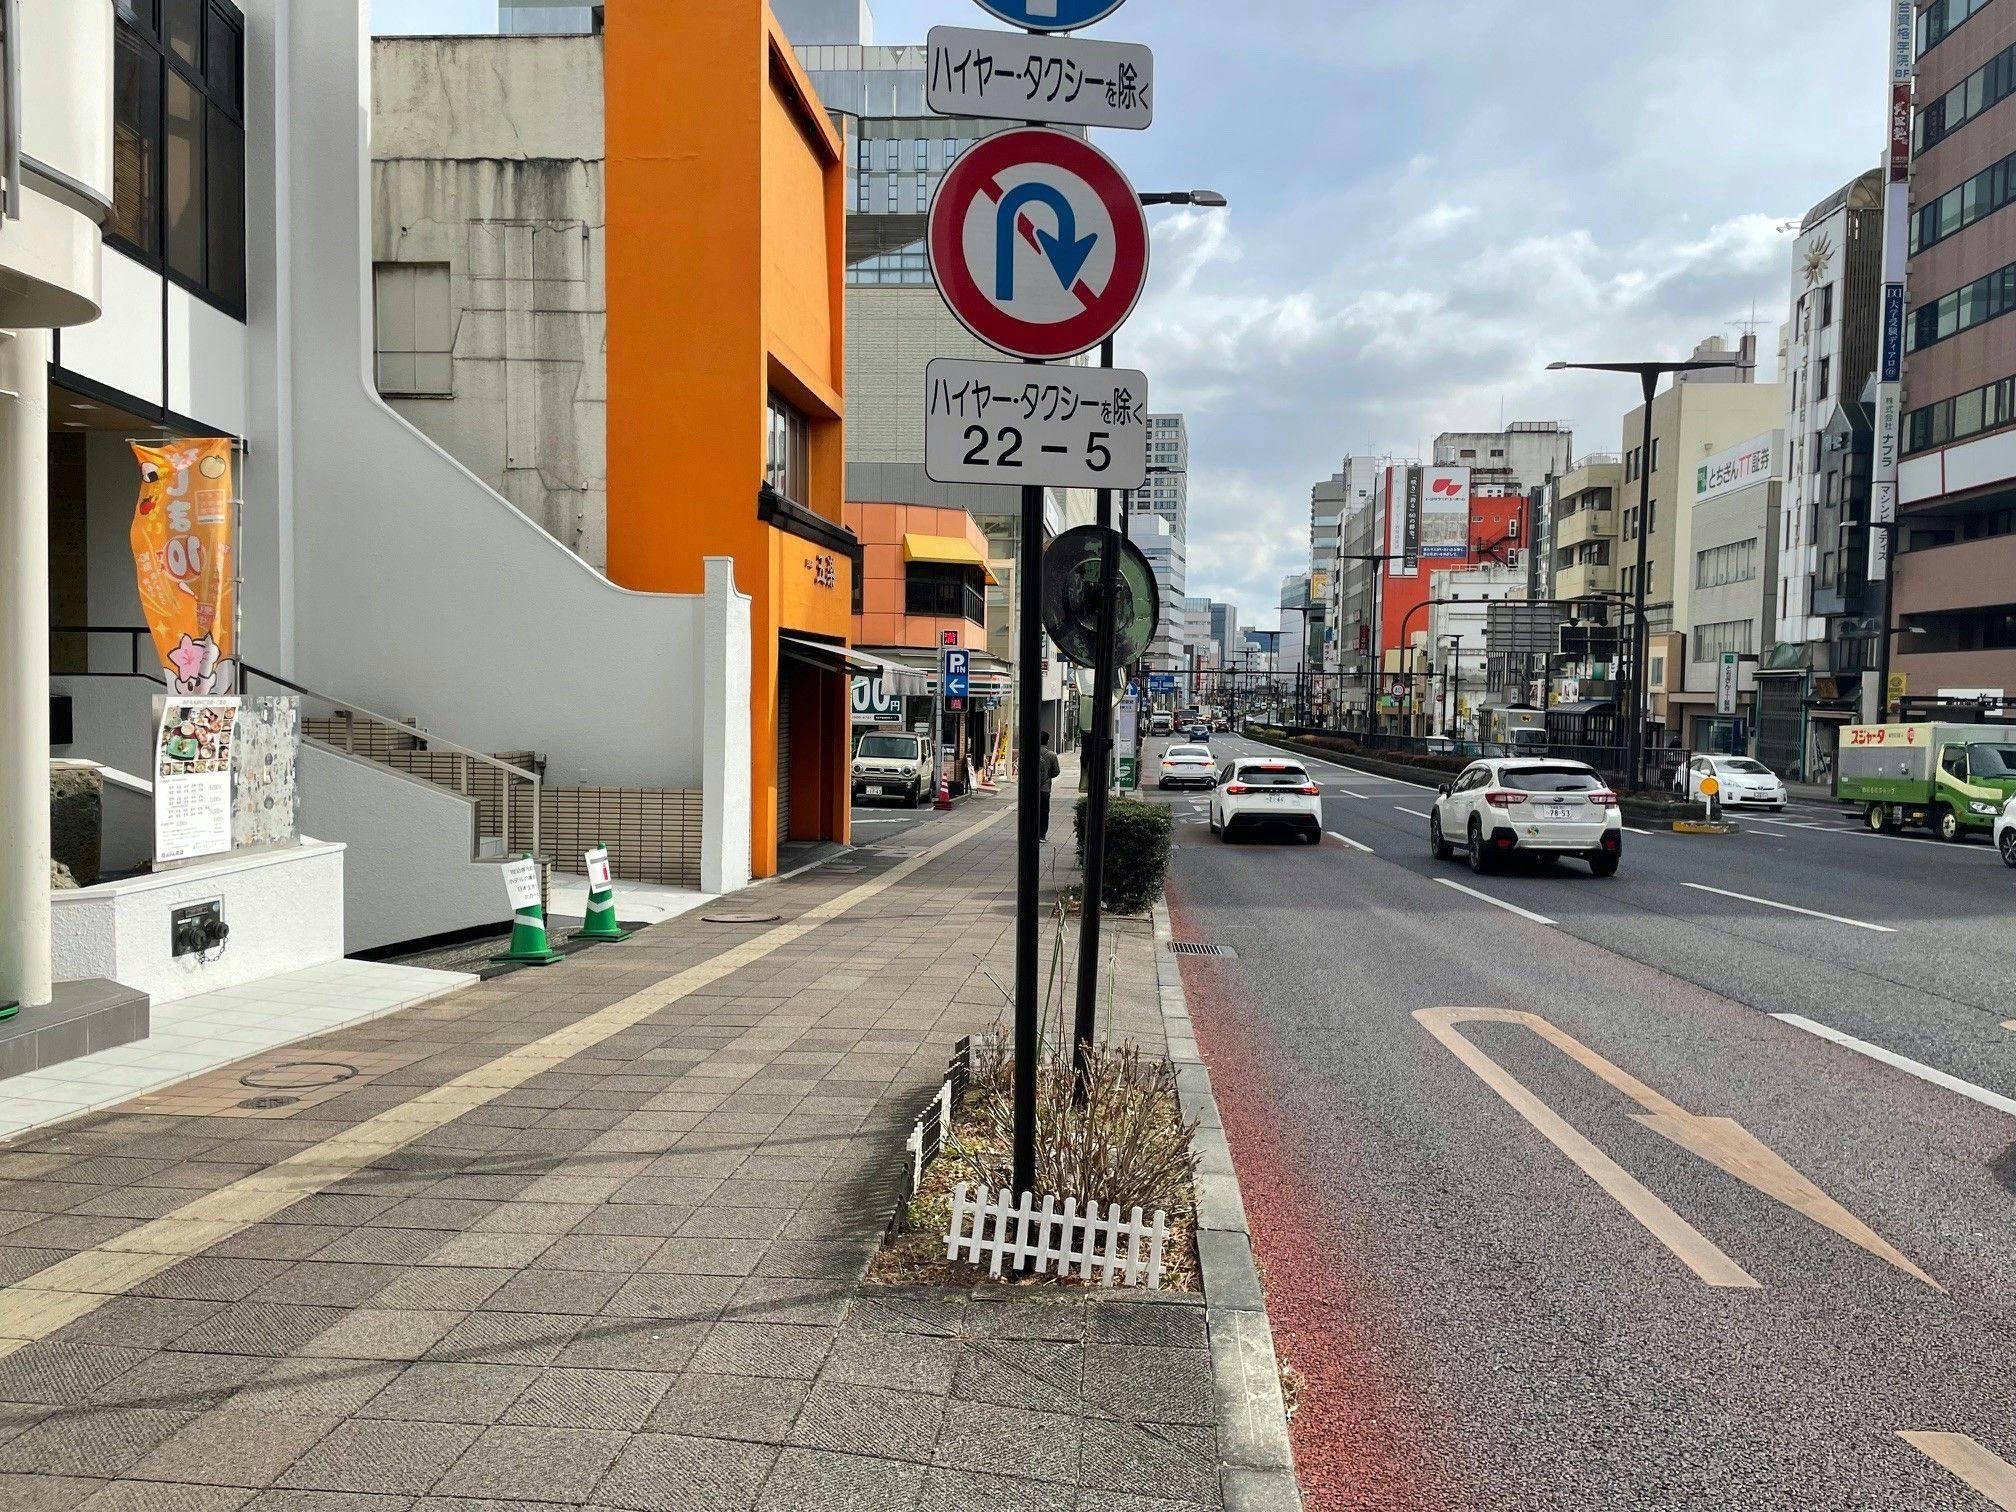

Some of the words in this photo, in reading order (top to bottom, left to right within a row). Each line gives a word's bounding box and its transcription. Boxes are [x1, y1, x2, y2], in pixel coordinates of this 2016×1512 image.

[932, 46, 1149, 110] ハイヤー・タクシーを除く
[931, 378, 1143, 426] ハイヤー・タクシーを除く
[1709, 447, 1770, 489] とちぎんTT証券
[1850, 728, 1885, 745] スジャータ
